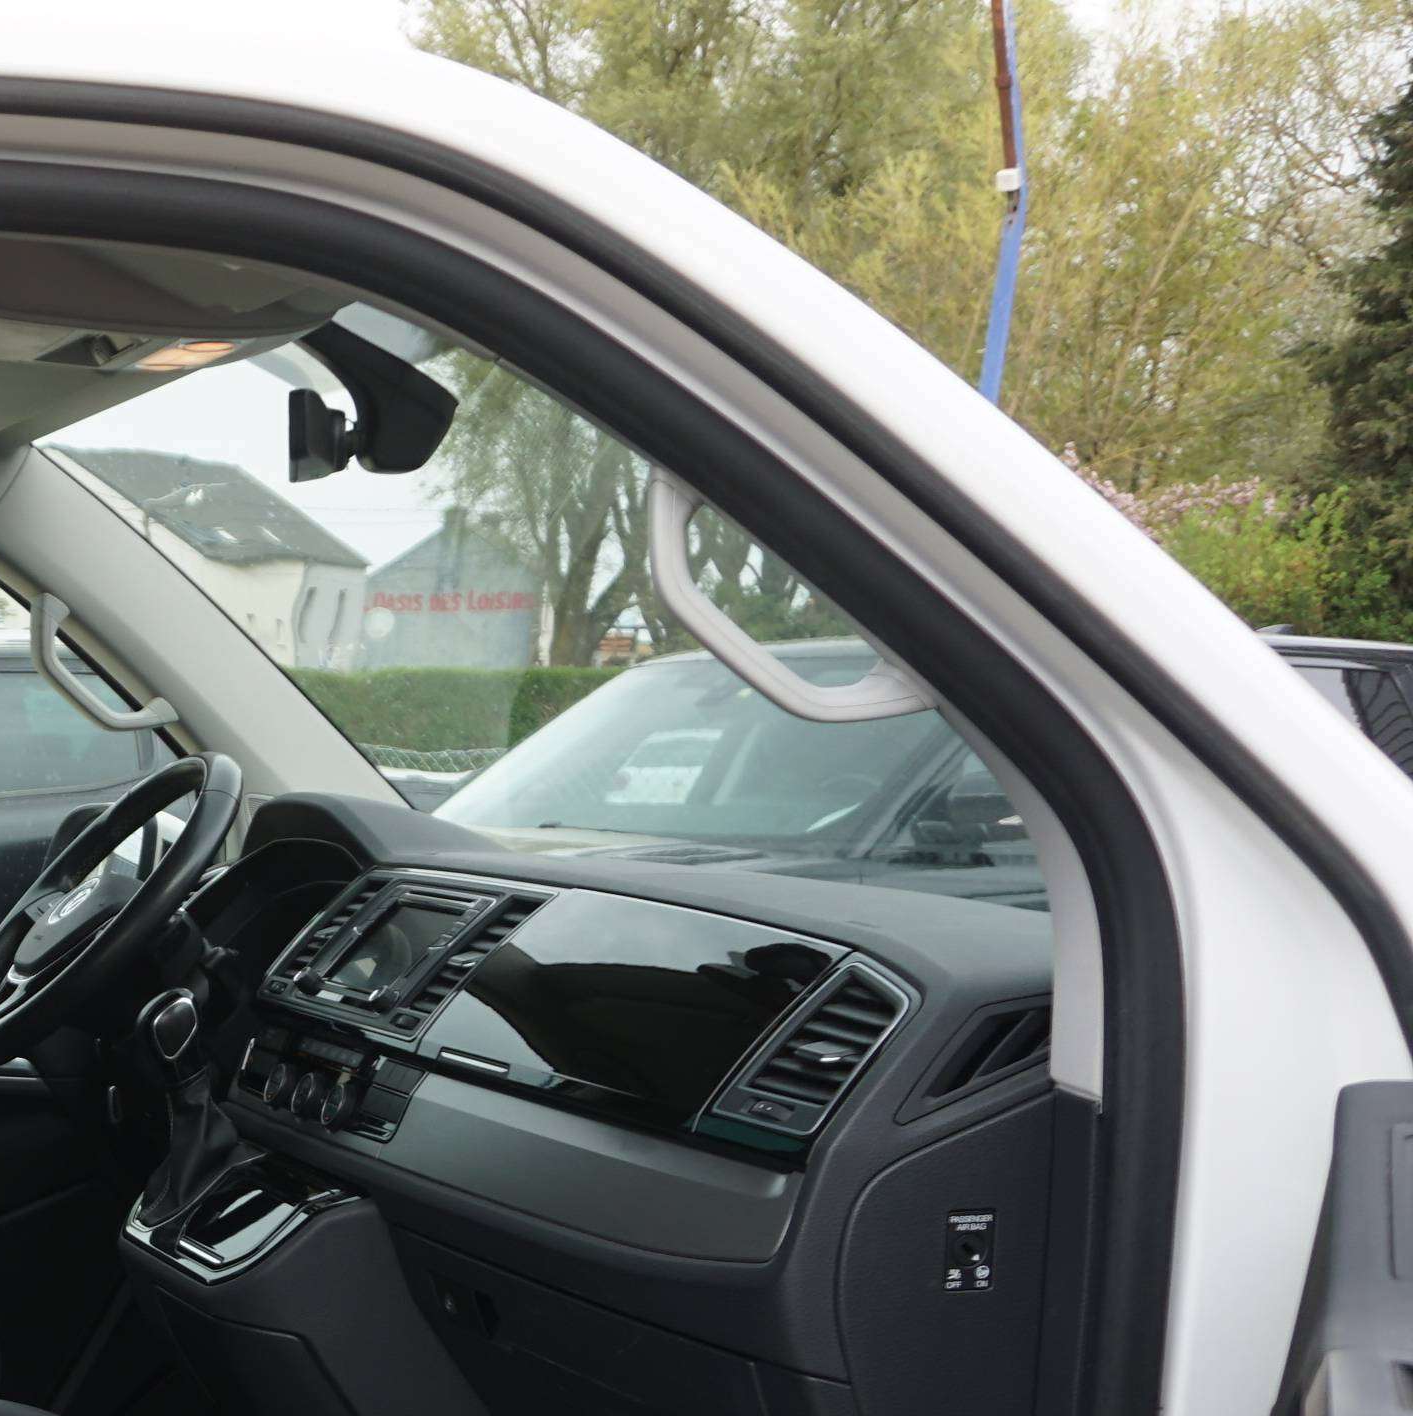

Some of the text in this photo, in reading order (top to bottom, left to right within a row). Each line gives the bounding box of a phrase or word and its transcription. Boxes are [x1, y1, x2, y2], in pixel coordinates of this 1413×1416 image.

[949, 1214, 993, 1223] PASSENGER
[946, 1281, 962, 1289] OFF
[976, 1280, 989, 1288] ON
